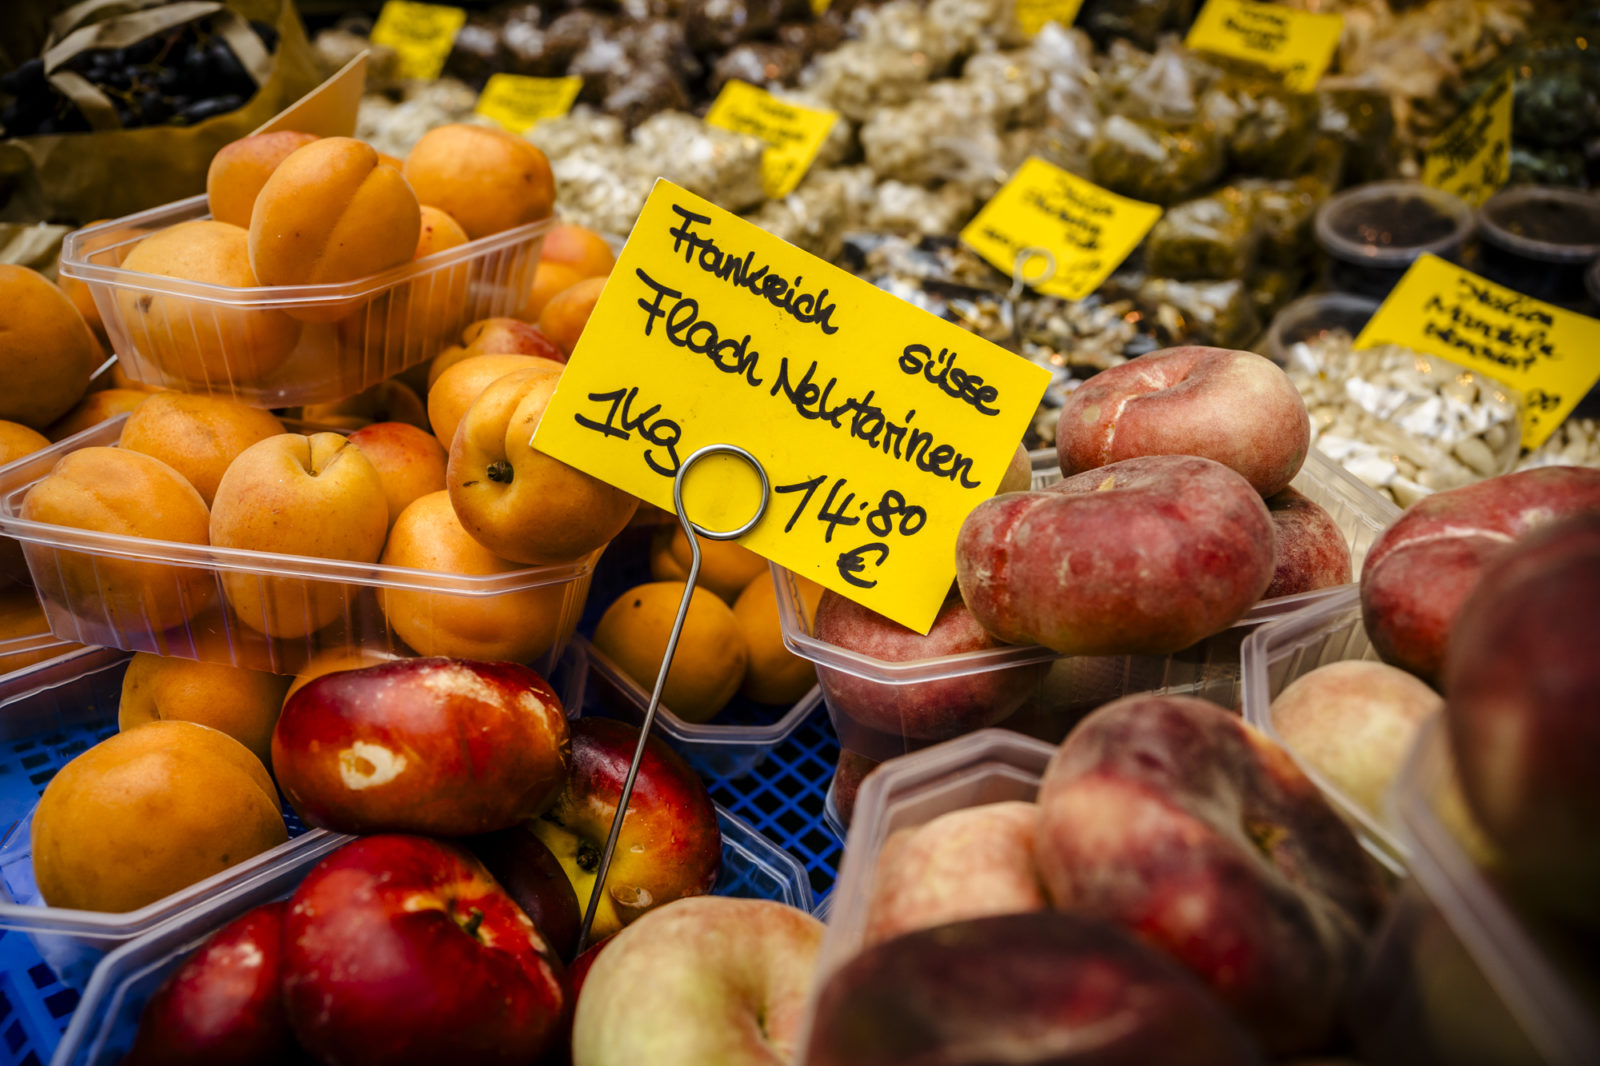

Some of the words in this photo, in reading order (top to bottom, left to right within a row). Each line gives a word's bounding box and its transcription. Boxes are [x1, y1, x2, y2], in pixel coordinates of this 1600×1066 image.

[669, 203, 839, 335] Frankreich
[635, 268, 764, 387] Flach
[770, 357, 981, 489] Nektarinen
[836, 542, 889, 589] €
